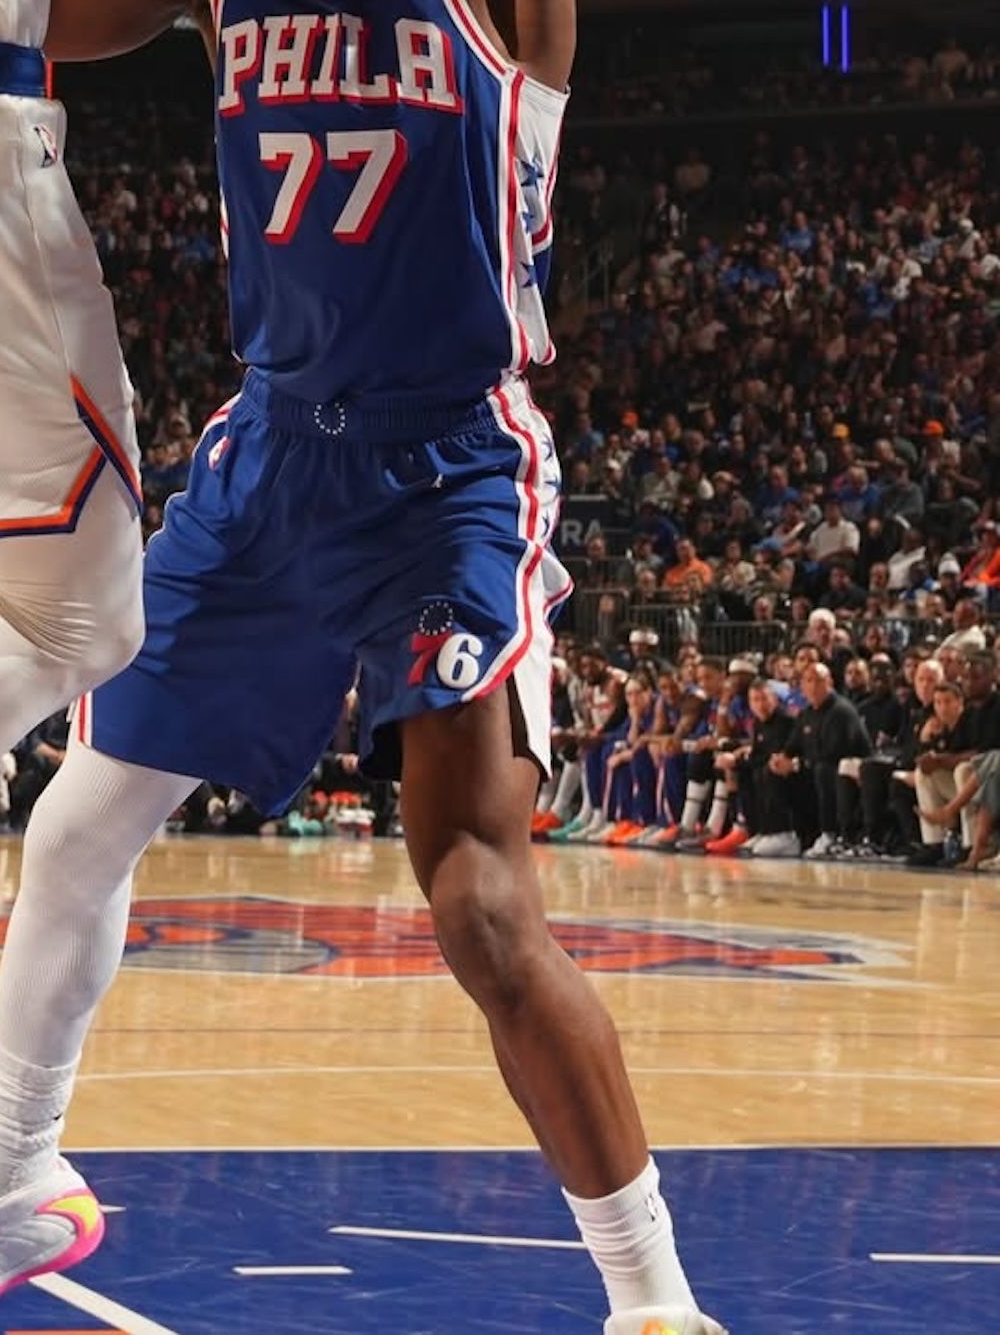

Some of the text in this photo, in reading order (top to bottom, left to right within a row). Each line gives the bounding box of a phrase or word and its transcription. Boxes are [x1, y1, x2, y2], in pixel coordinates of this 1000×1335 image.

[218, 13, 464, 117] PHILA
[259, 129, 408, 245] 77
[407, 629, 484, 690] 76
